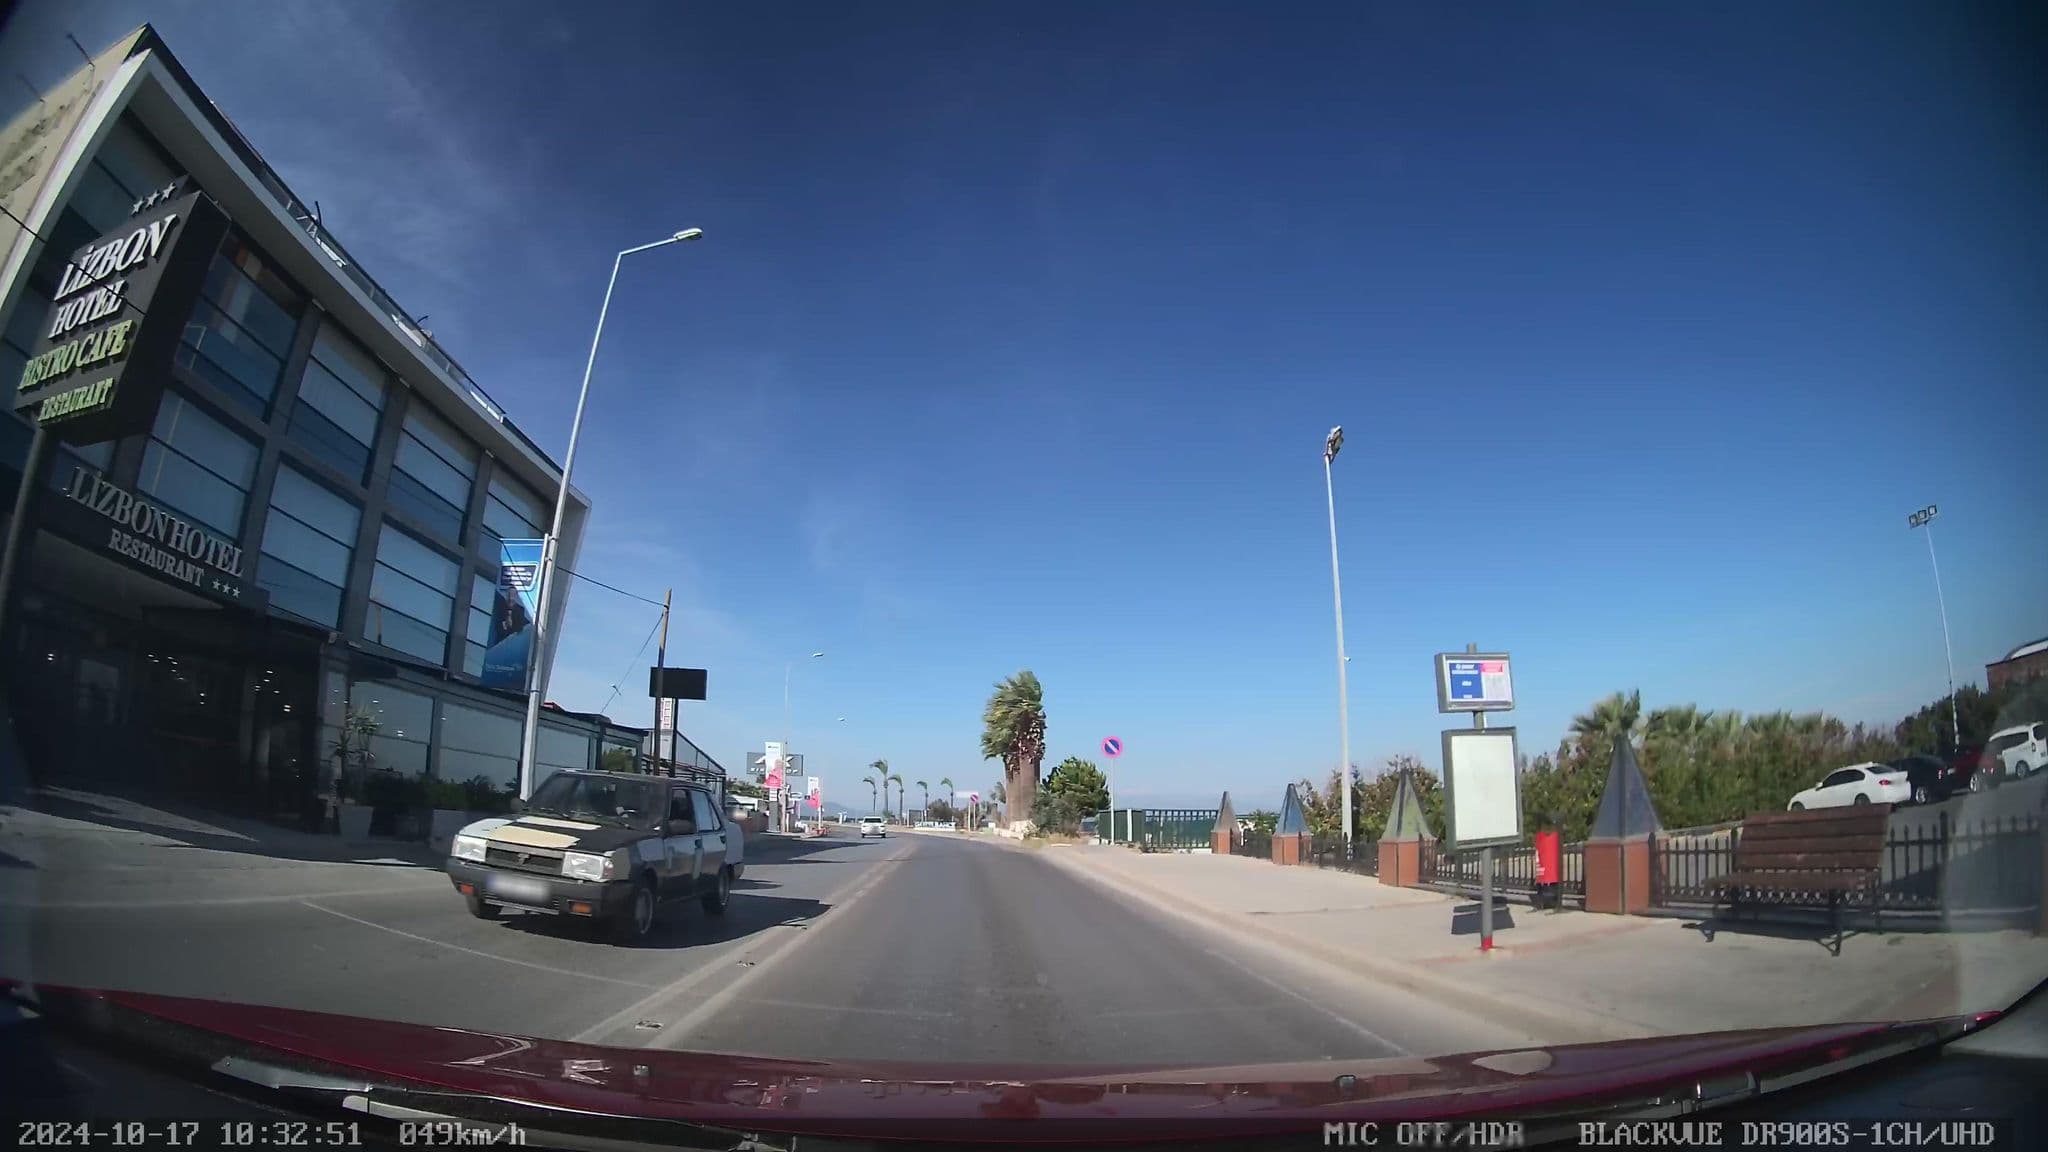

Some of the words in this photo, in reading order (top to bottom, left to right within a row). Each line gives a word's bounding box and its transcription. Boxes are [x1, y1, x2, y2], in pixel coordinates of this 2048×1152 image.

[54, 213, 177, 301] LİZBON
[47, 279, 127, 339] HOTEL
[37, 377, 114, 422] RESTAURANT
[67, 465, 170, 543] LİZBON
[168, 517, 243, 578] HOTEL
[107, 527, 205, 588] RESTAURANT
